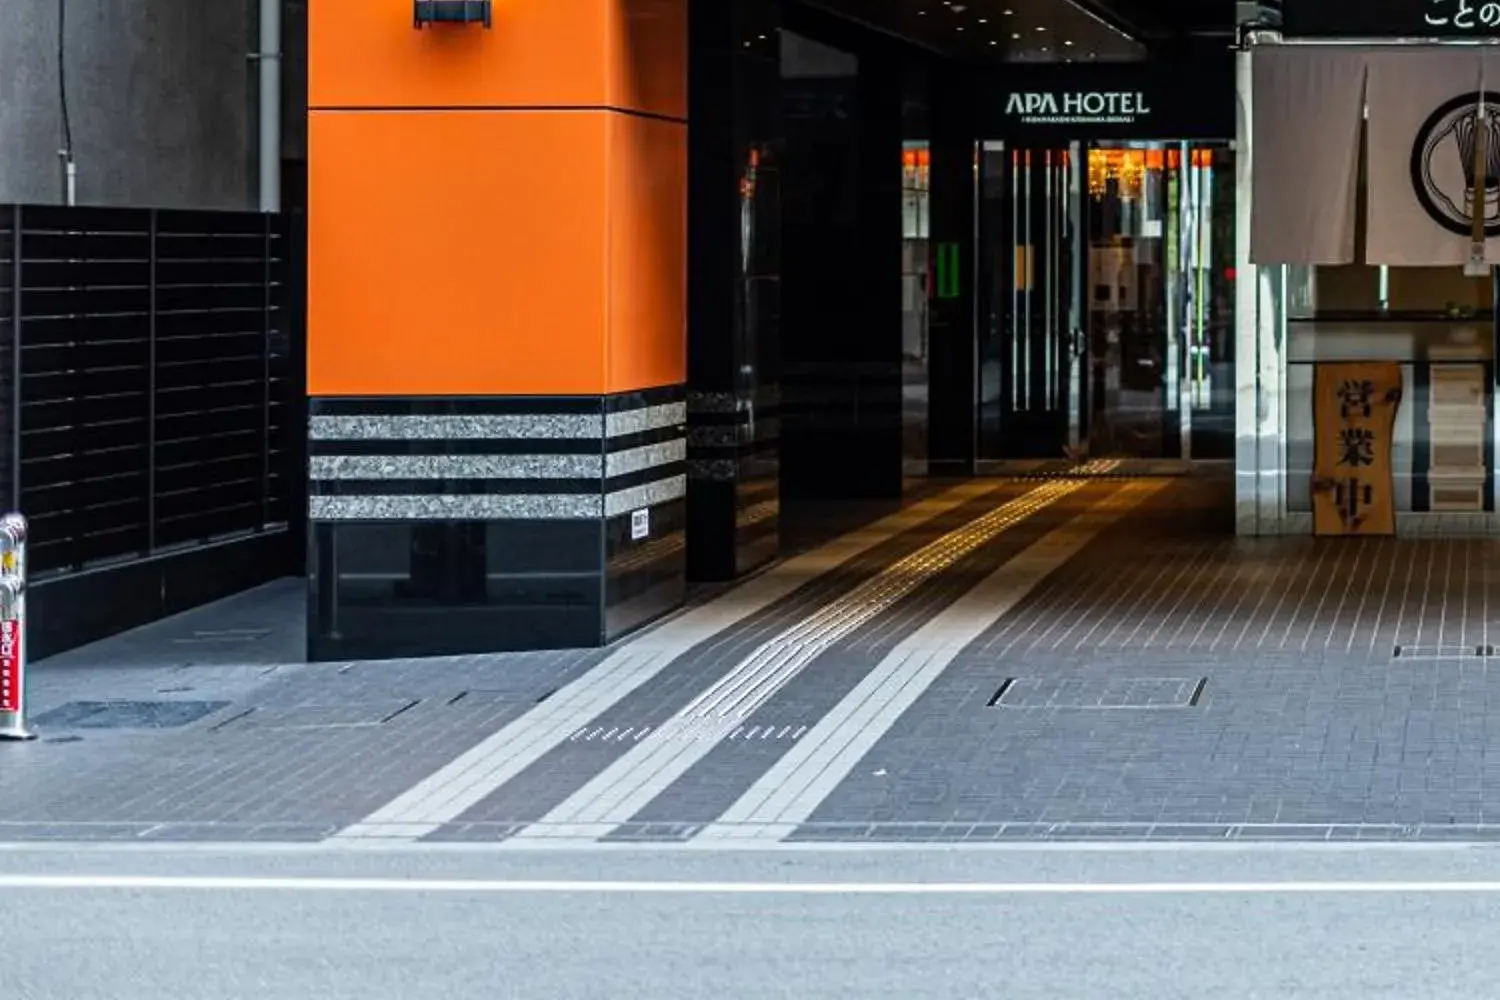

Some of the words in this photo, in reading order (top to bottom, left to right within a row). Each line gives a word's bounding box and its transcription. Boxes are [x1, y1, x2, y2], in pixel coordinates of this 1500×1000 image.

[1005, 92, 1059, 115] APA
[1063, 92, 1150, 115] HOTEL
[1336, 379, 1376, 518] 営業中
